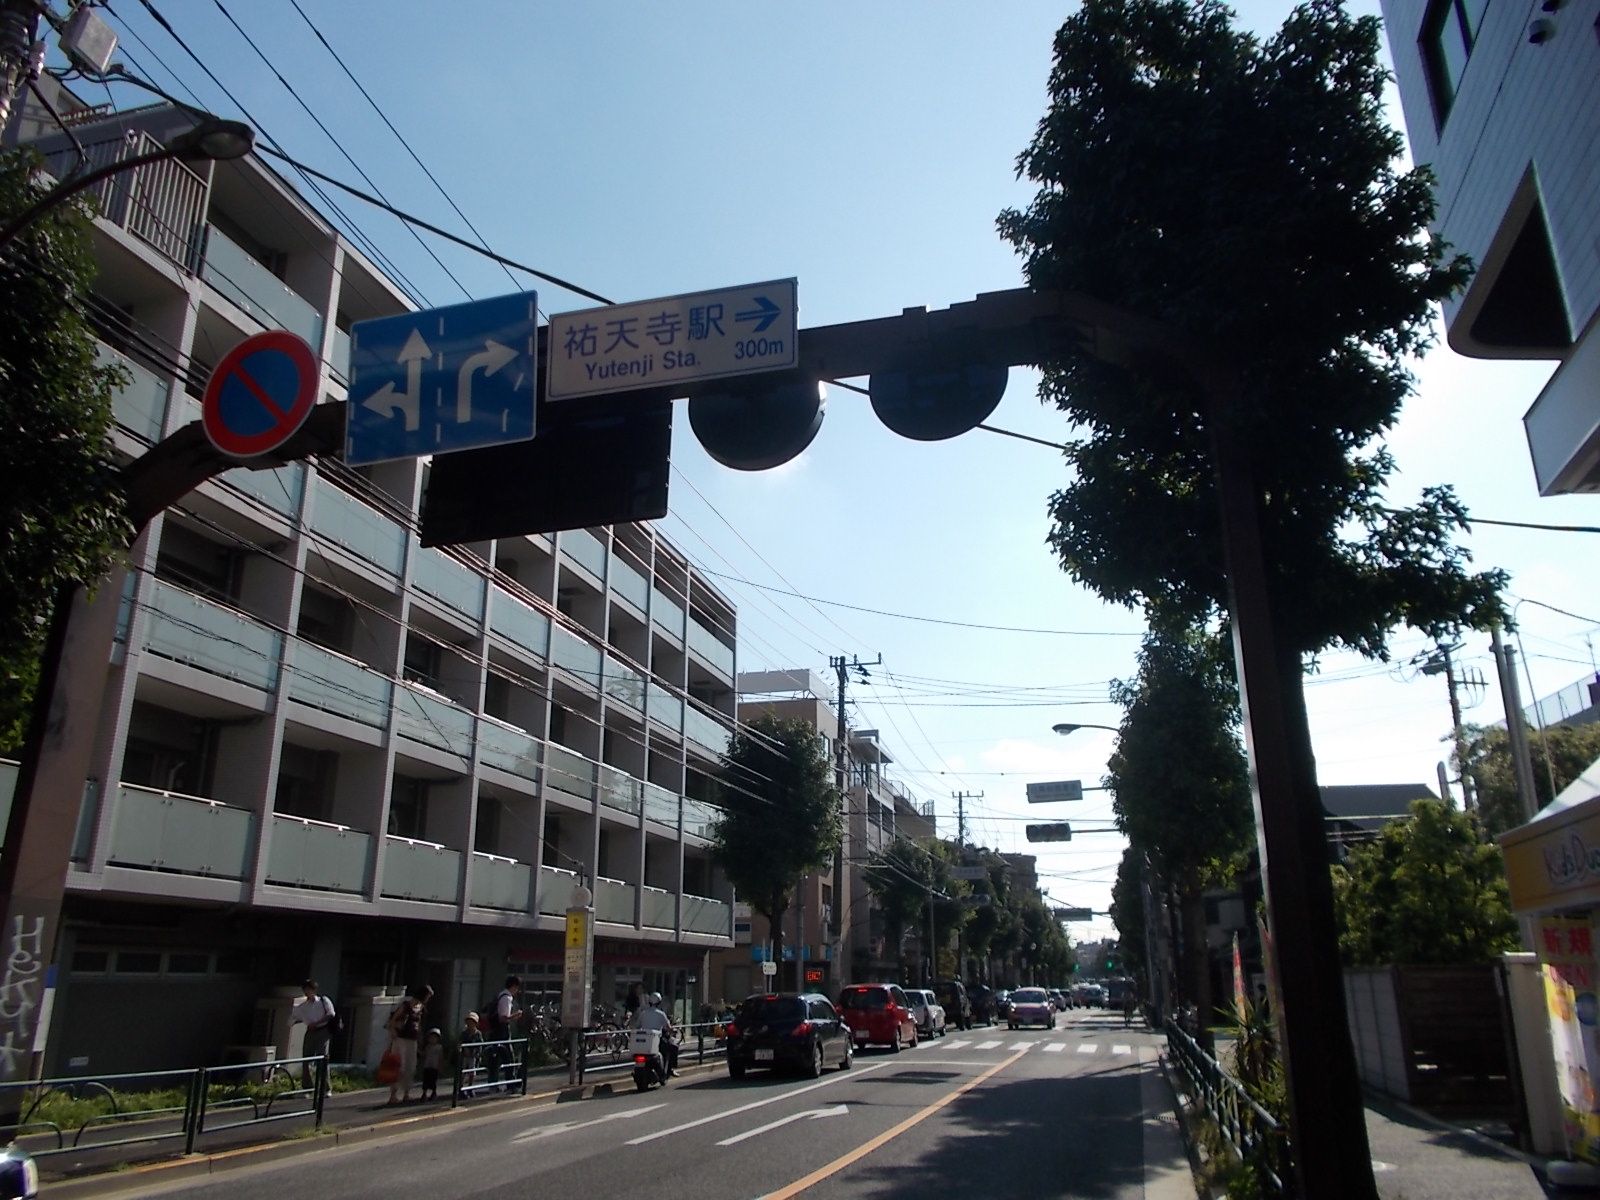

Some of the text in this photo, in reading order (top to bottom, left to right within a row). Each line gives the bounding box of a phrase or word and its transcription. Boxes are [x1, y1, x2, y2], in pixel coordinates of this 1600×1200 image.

[564, 304, 726, 359] 祐天寺駅
[734, 338, 784, 360] 300m
[586, 350, 701, 381] Yutenji Sta.
